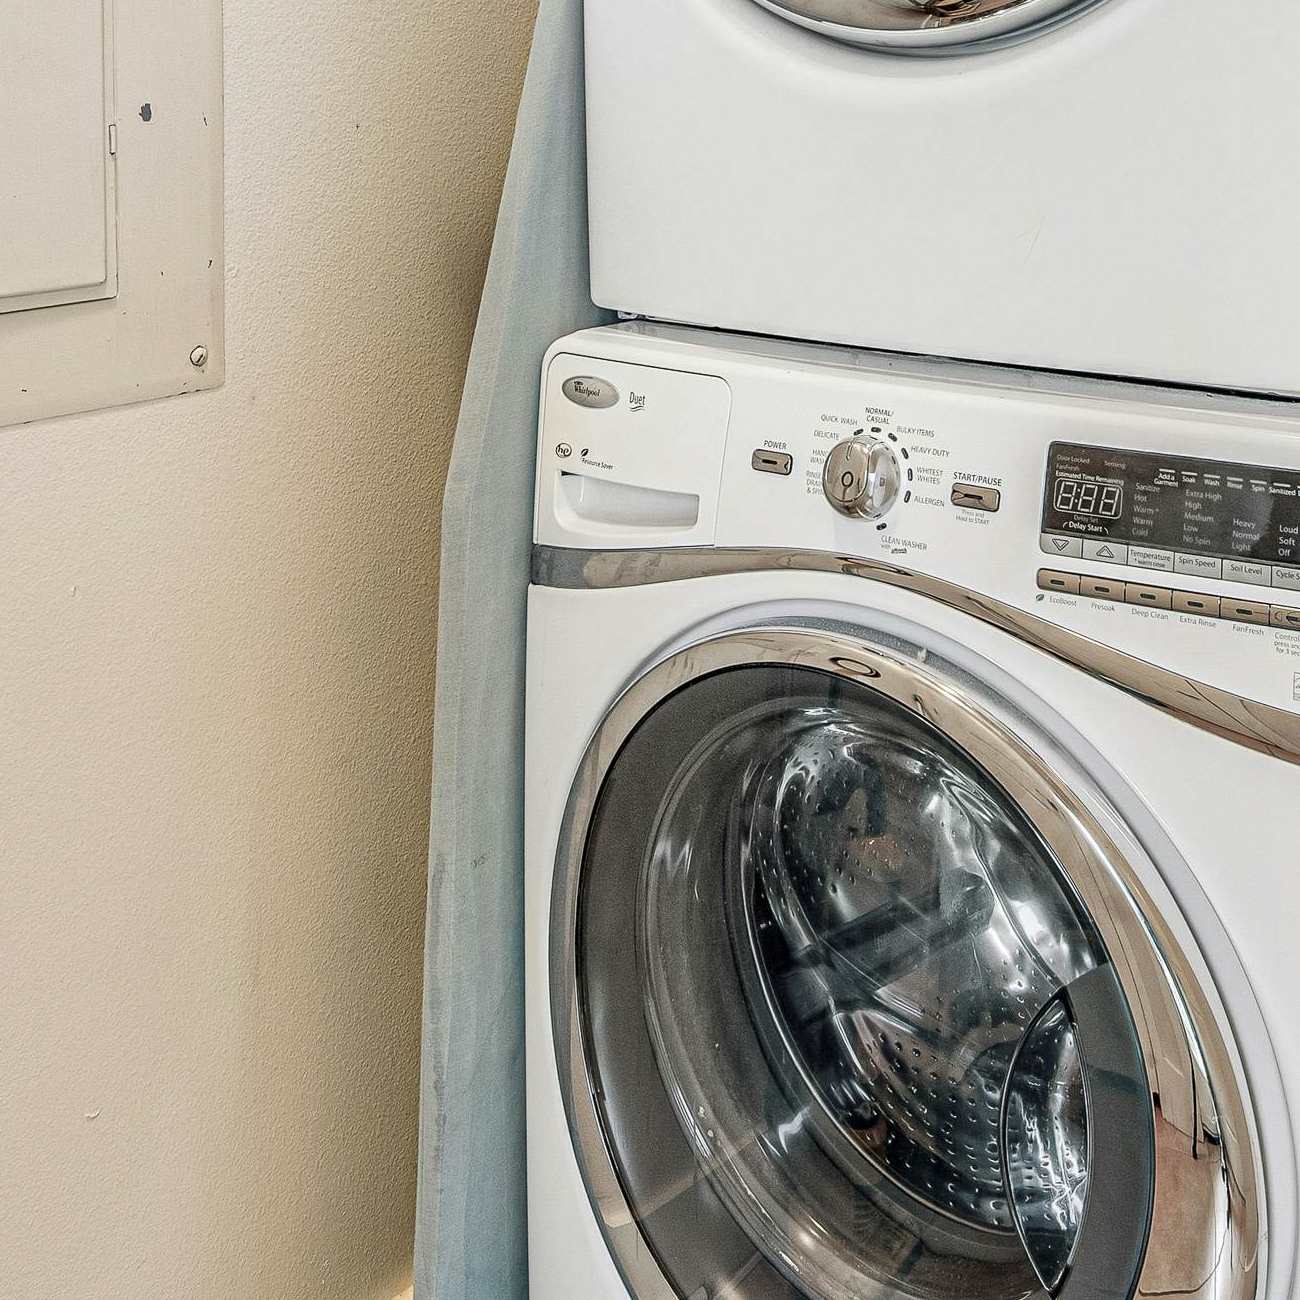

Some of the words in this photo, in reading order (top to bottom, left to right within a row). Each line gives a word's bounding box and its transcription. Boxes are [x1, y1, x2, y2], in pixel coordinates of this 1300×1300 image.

[574, 382, 600, 397] Whirlpool
[629, 391, 646, 405] Duet
[865, 406, 894, 417] NORMAL/
[820, 414, 839, 423] QUICK
[840, 416, 858, 426] WASH
[866, 415, 890, 425] CASUAL
[813, 429, 840, 441] DELICATE
[897, 425, 916, 436] BULKY
[916, 428, 935, 438] ITEMS
[763, 440, 787, 450] POWER
[911, 445, 930, 455] HEAVY
[931, 447, 950, 457] DUTY
[1071, 456, 1090, 464] Locked
[1104, 460, 1126, 469] Sensing
[916, 466, 943, 476] WHITEST
[916, 474, 941, 485] WHITES
[953, 471, 1002, 487] START/PAUSE
[1056, 470, 1081, 479] Estimated
[1082, 473, 1095, 481] Time
[1096, 475, 1124, 486] Remaining
[1153, 478, 1179, 487] Garment
[1135, 483, 1160, 492] Sanitize
[1227, 481, 1243, 489] Rinse
[1252, 484, 1265, 492] Spin
[1185, 489, 1203, 498] Extra
[1204, 491, 1222, 501] High
[1269, 486, 1296, 496] Sanitized
[914, 495, 945, 507] ALLERGEN
[1134, 493, 1147, 502] Hot
[1185, 501, 1202, 510] High
[974, 517, 989, 525] START
[1133, 516, 1153, 526] Warm
[1184, 512, 1214, 522] Medium
[1069, 521, 1087, 530] Delay
[1087, 523, 1103, 532] Start
[1183, 523, 1199, 532] Low
[1232, 517, 1256, 530] Heavy
[1132, 527, 1148, 536] Cold
[1279, 525, 1299, 534] Loud
[1183, 534, 1193, 542] No
[1195, 536, 1211, 546] Spin
[1232, 530, 1260, 540] Normal
[881, 534, 901, 546] CLEAN
[902, 540, 928, 550] WASHER
[1278, 537, 1295, 546] Soft
[1232, 542, 1251, 552] Light
[1278, 548, 1291, 556] Off
[1130, 549, 1171, 562] Temperature
[1178, 556, 1194, 565] Spin
[1194, 558, 1216, 569] Speed
[1230, 564, 1243, 573] Soil
[1244, 566, 1262, 575] Level
[1275, 570, 1295, 580] Cycle
[1049, 596, 1077, 606] EcoBoost
[1091, 602, 1115, 612] Presoak
[1131, 608, 1149, 619] Deep
[1150, 611, 1169, 620] Clean
[1180, 616, 1197, 625] Extra
[1198, 618, 1217, 628] Rinse
[1232, 624, 1264, 636] FanFresh
[1274, 632, 1300, 642] Control
